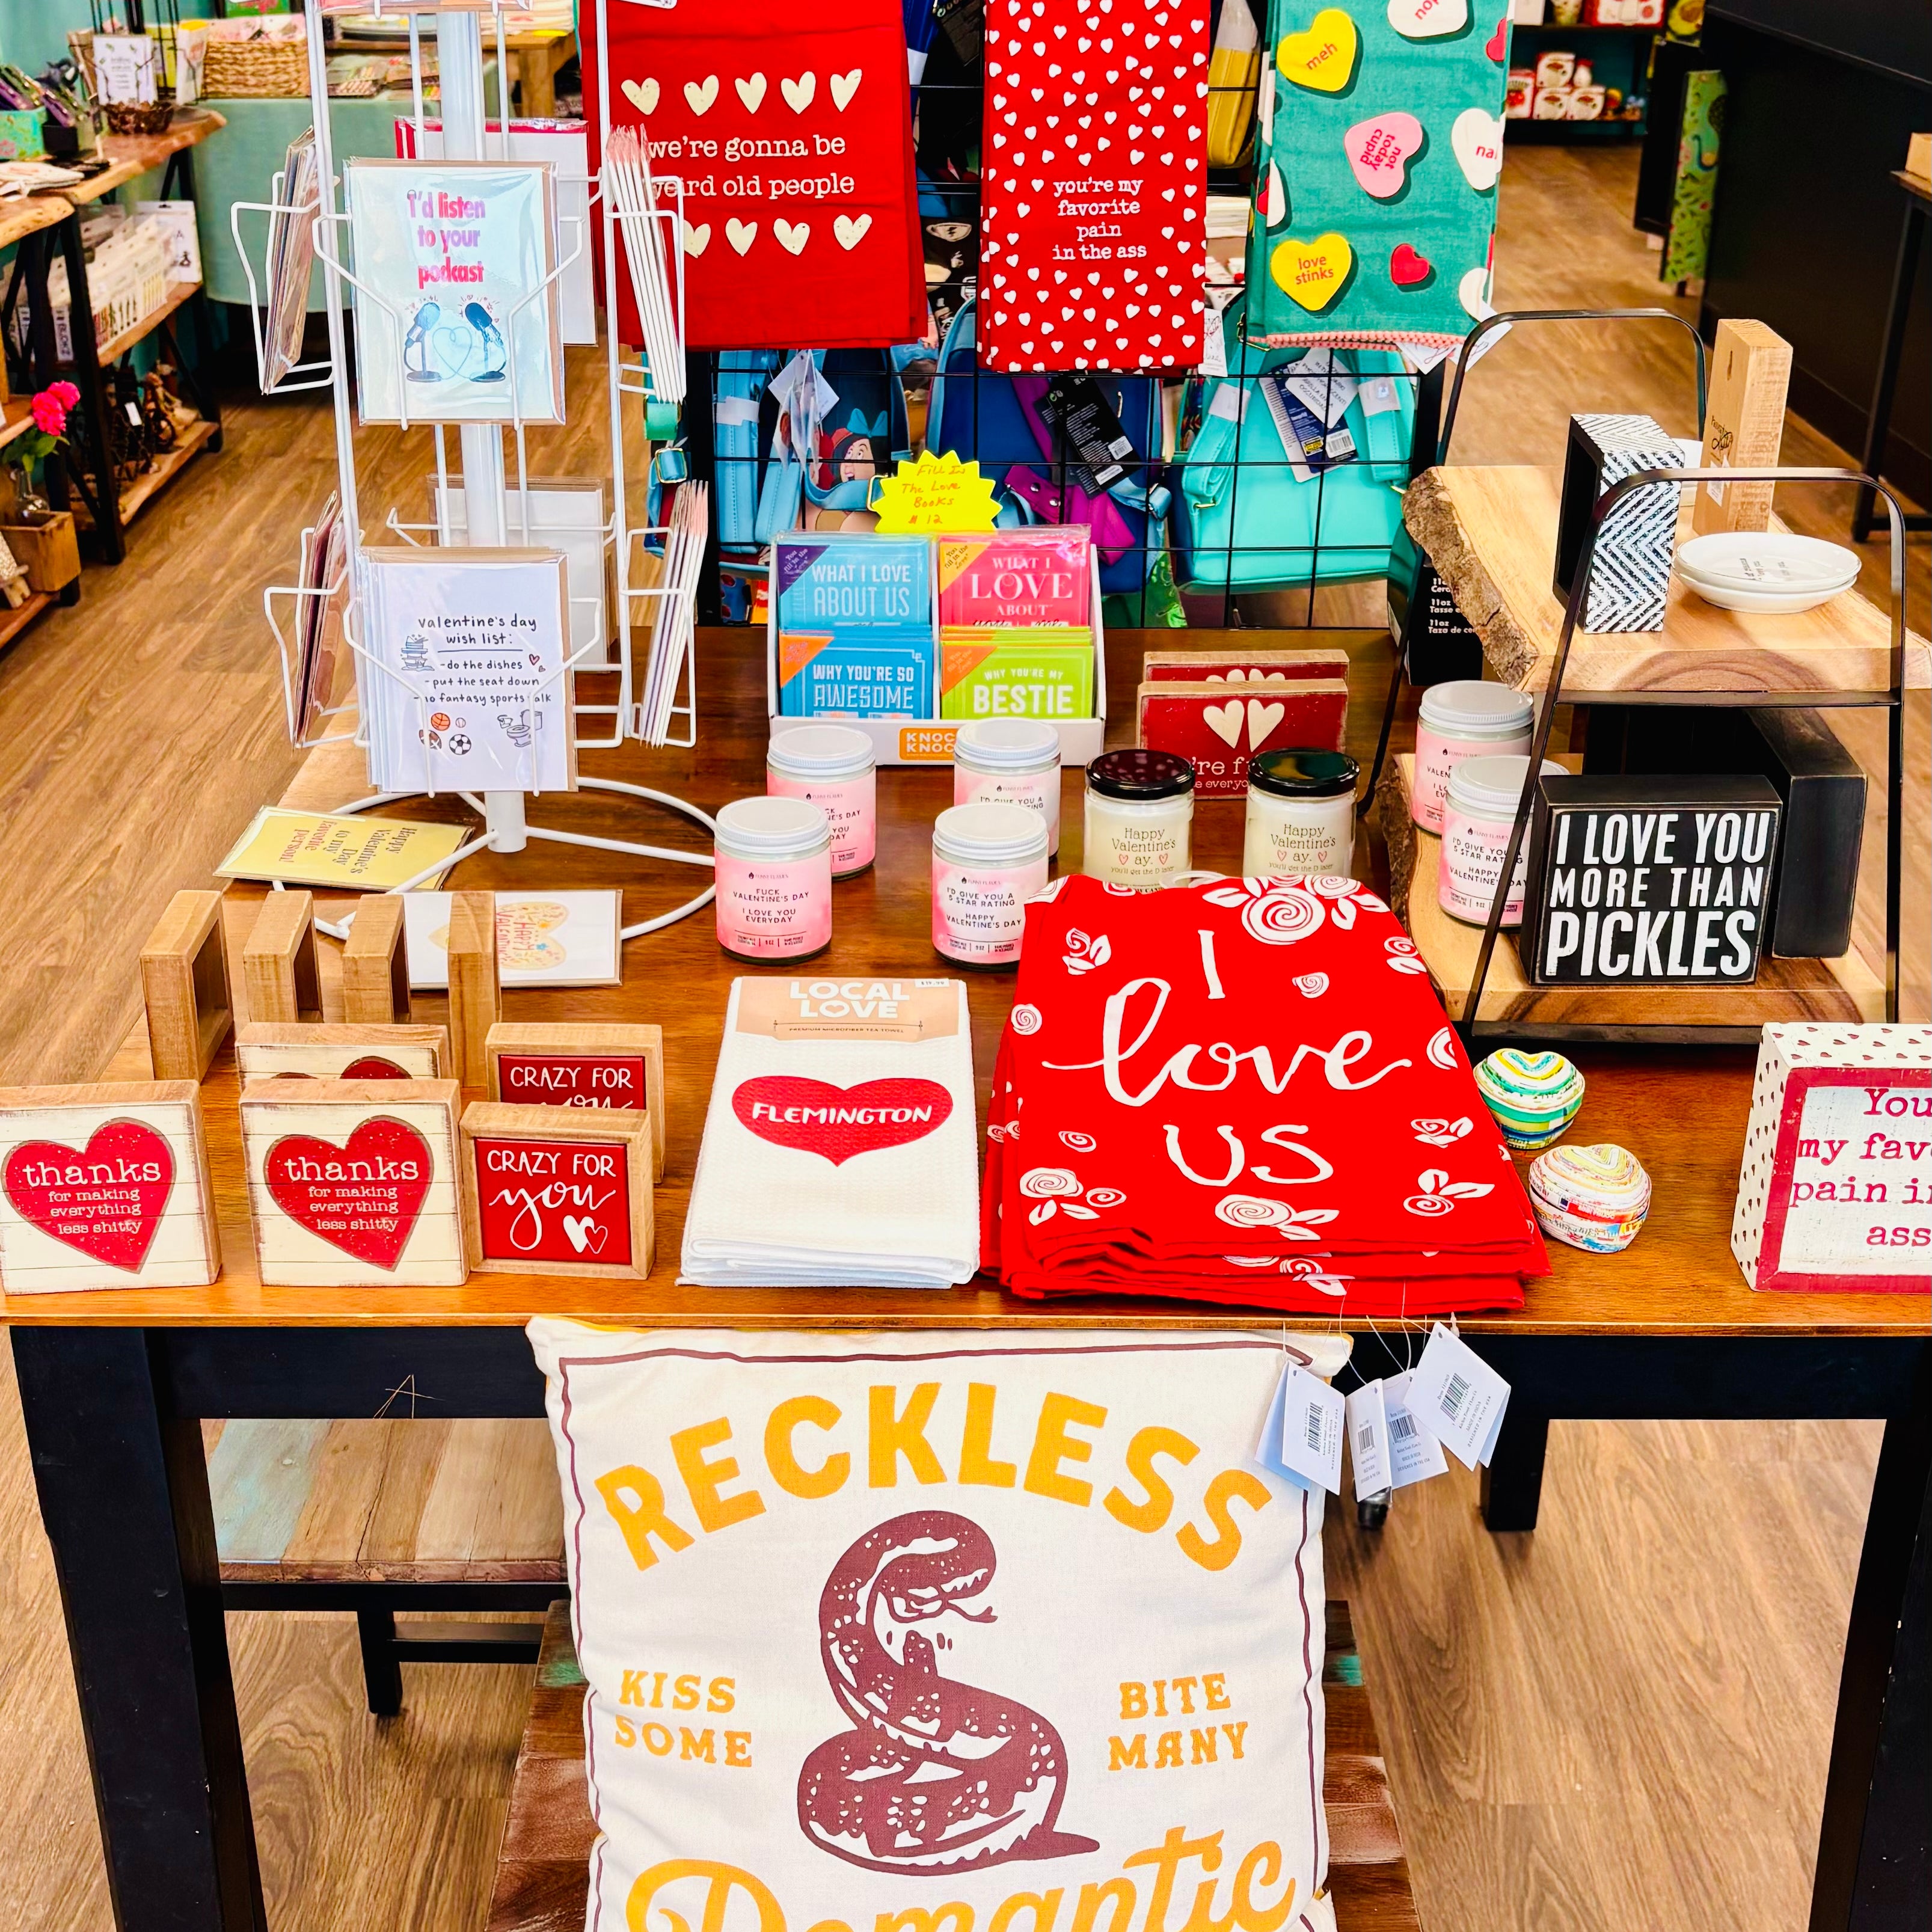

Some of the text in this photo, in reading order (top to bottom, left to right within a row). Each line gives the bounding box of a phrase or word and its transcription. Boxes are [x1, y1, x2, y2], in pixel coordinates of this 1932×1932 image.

[1306, 42, 1339, 71] meh
[649, 134, 845, 162] we're gonna be
[1360, 129, 1382, 165] cupid
[1370, 134, 1395, 171] today
[1385, 147, 1402, 169] not
[723, 173, 854, 200] old people
[1053, 176, 1144, 198] you're my
[407, 190, 486, 218] I'd listen
[1057, 198, 1141, 216] favorite
[417, 225, 480, 254] to your
[1076, 221, 1122, 242] pain
[1052, 244, 1147, 260] in the ass
[1297, 255, 1327, 271] love
[418, 257, 485, 289] podcast
[1295, 268, 1334, 286] stinks
[902, 480, 960, 494] The Love
[927, 514, 942, 524] 12
[993, 557, 1050, 569] WHAT I
[812, 564, 856, 582] WHAT
[861, 564, 866, 582] I
[872, 565, 911, 582] LOVE
[970, 572, 1073, 600] LOVE
[814, 586, 910, 616] ABOUT US
[510, 613, 537, 631] day
[446, 633, 513, 645] wish list:
[463, 658, 523, 670] the dishes
[813, 664, 914, 681] WHY YOU'RE SO
[433, 676, 539, 688] put the seat down
[984, 668, 1063, 681] WHY YOU'RE MY
[440, 693, 525, 707] fantasy sports
[814, 684, 914, 709] AWESOME
[974, 685, 1073, 714] BESTIE
[906, 732, 955, 743] KNOC
[906, 743, 954, 753] KNOC
[846, 809, 860, 818] DAY
[305, 820, 337, 851] favorite
[385, 827, 417, 854] Happy
[1124, 827, 1165, 841] Happy
[1284, 824, 1325, 838] Happy
[1556, 812, 1770, 865] I LOVE YOU
[279, 829, 310, 862] person!
[323, 839, 343, 854] my
[1112, 838, 1176, 852] Valentine's
[1271, 834, 1336, 849] Valentine's
[1453, 837, 1485, 853] I'D GIVE
[333, 848, 358, 865] Day
[351, 830, 393, 874] Valentine's
[1135, 856, 1153, 866] ay.
[1293, 853, 1312, 863] ay.
[1461, 848, 1481, 860] STAR
[1450, 866, 1498, 885] VALENTINE'
[1469, 866, 1499, 877] HAPPY
[733, 891, 809, 902] VALENTINE'S DAY
[960, 891, 979, 900] GIVE
[1550, 866, 1764, 908] MORE THAN
[957, 897, 977, 907] STAR
[746, 915, 793, 924] EVERYDAY
[946, 915, 1022, 928] VALENTINE'S DAY
[512, 922, 536, 951] HAPPY
[1545, 910, 1756, 977] PICKLES
[1197, 929, 1225, 1000] I
[790, 981, 910, 1001] LOCAL
[800, 999, 898, 1019] LOVE
[1041, 977, 1412, 1107] love
[510, 1067, 634, 1091] CRAZY FOR
[752, 1102, 933, 1125] FLEMINGTON
[1798, 1139, 1849, 1166] my
[22, 1158, 162, 1188] thanks
[284, 1156, 419, 1182] thanks
[487, 1150, 616, 1177] CRAZY FOR
[48, 1189, 141, 1203] for making
[308, 1186, 397, 1199] for making
[1789, 1176, 1888, 1208] pain
[50, 1203, 142, 1218] everything
[310, 1201, 399, 1215] everything
[488, 1181, 616, 1251] you
[57, 1220, 142, 1234] less shitty
[316, 1218, 399, 1232] less shitty
[1866, 1225, 1932, 1247] ass
[594, 1381, 1274, 1572] RECKLESS
[619, 1668, 738, 1714] KISS
[1119, 1671, 1232, 1720] BITE
[615, 1713, 754, 1768] SOME
[1108, 1720, 1250, 1771] MANY
